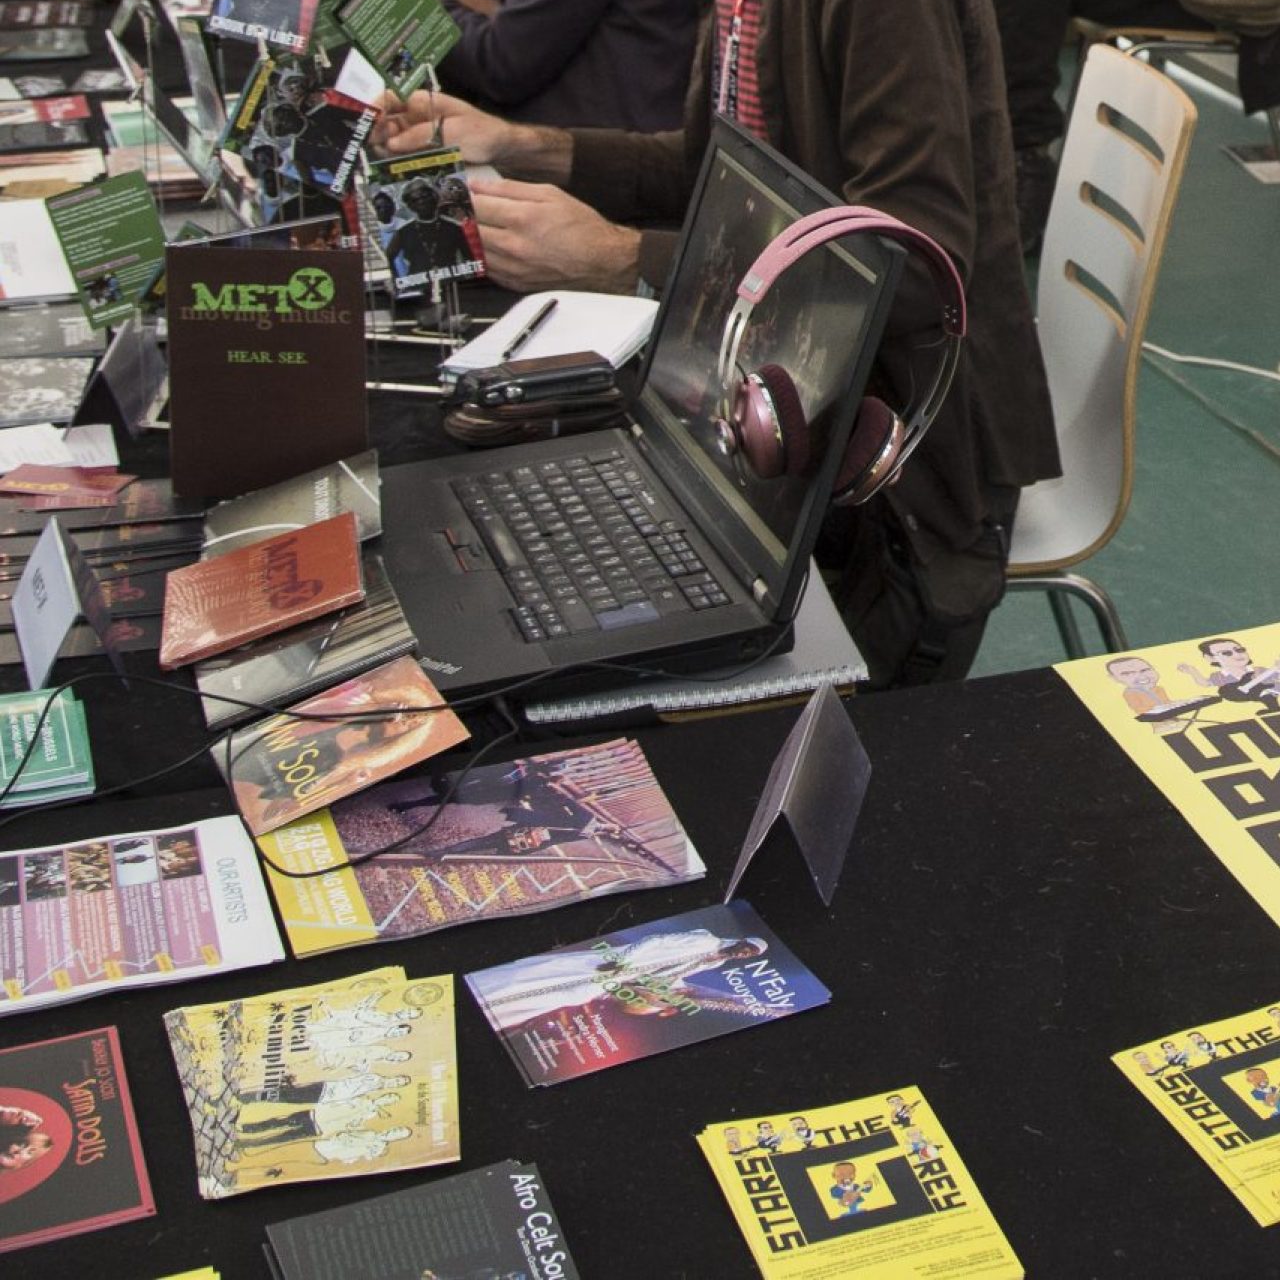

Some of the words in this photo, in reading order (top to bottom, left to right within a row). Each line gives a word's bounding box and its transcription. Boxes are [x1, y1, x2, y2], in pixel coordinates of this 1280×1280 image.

[217, 857, 237, 886] OUR
[221, 883, 248, 924] ARTISTS
[746, 959, 797, 1008] N'Faly
[290, 1004, 313, 1053] Vocal
[1214, 1025, 1280, 1055] THE
[815, 1115, 885, 1145] THE
[1155, 1072, 1251, 1152] STARS
[509, 1173, 537, 1210] Afro
[526, 1212, 558, 1253] Celt
[735, 1155, 807, 1254] STARS
